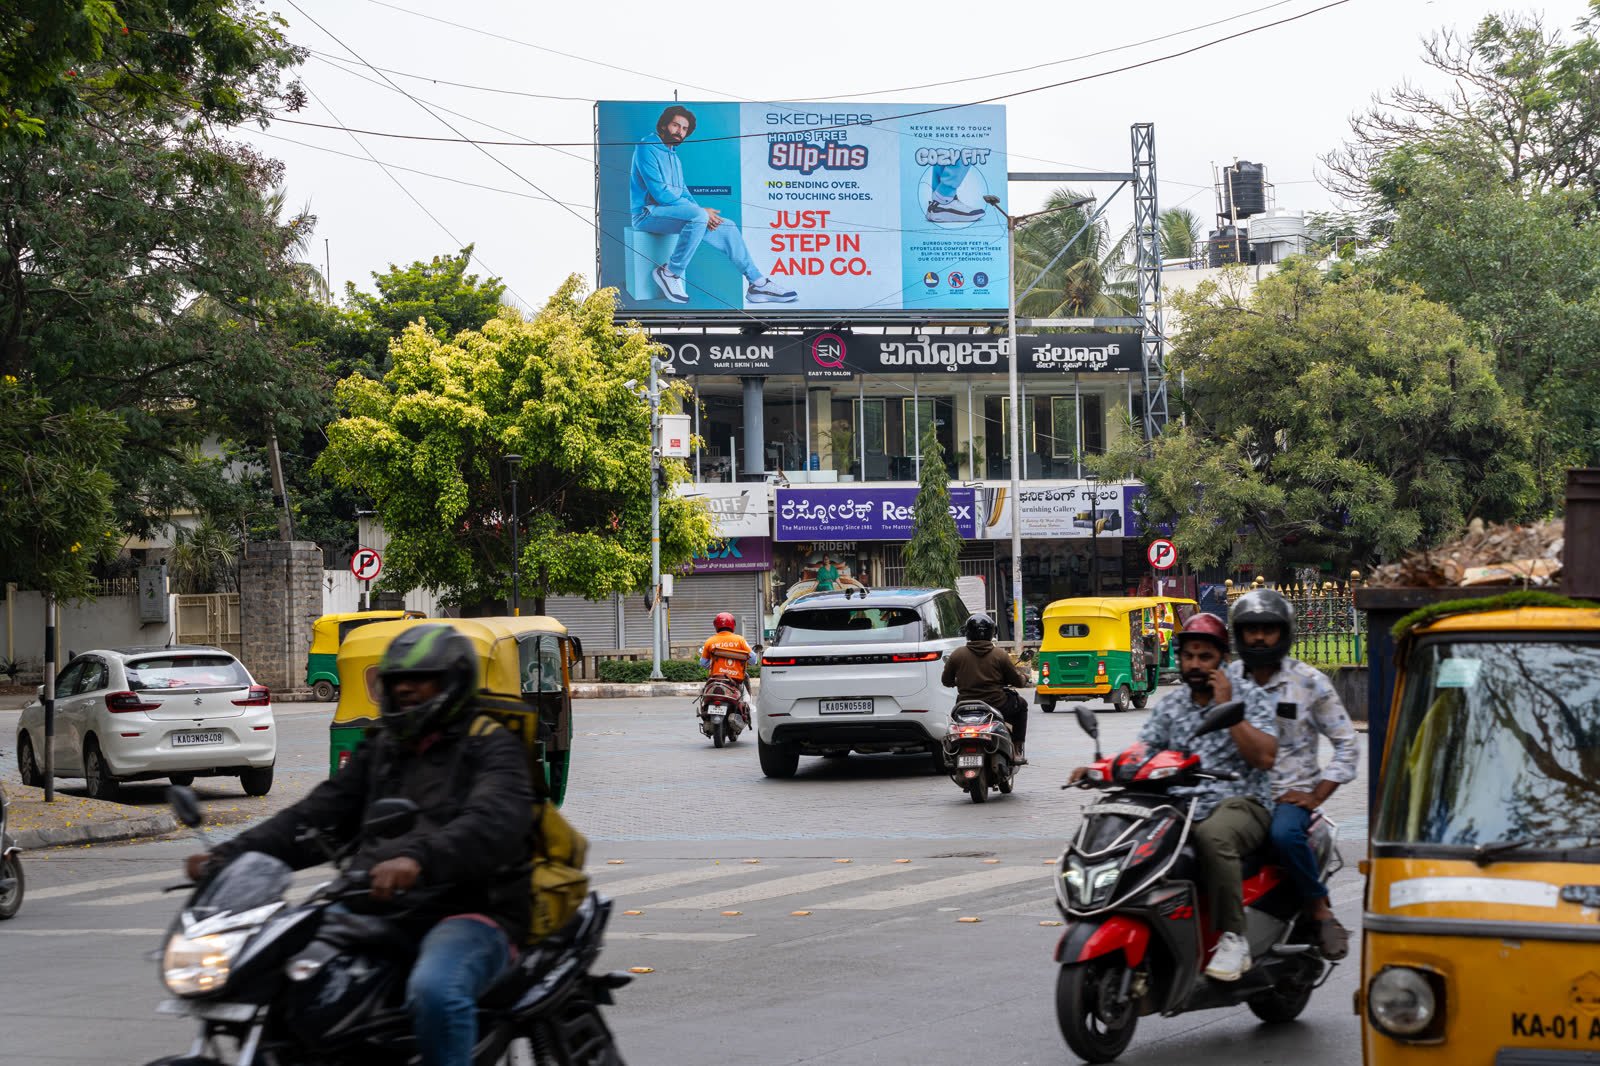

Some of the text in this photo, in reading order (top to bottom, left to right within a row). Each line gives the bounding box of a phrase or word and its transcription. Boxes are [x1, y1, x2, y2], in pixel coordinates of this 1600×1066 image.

[766, 113, 873, 125] SKECHERS
[768, 130, 847, 143] HANDS FREE
[769, 141, 868, 174] Slip-ins
[915, 147, 991, 166] COZY FIT
[768, 181, 860, 189] NO BENDING OVER.
[768, 192, 873, 201] NO TOUCHING SHOES.
[769, 210, 831, 229] JUST
[770, 234, 860, 252] STEP IN
[770, 257, 872, 276] AND GO.
[709, 345, 774, 360] SALON
[1032, 343, 1120, 362] ಸಲೂನ್
[781, 499, 875, 524] ರೆಸ್ಟೋಲೆಕ್ಸ್
[1019, 505, 1076, 513] urnishing Gallery
[812, 541, 857, 551] TRIDENT
[719, 667, 739, 676] Swiggy
[1511, 1011, 1579, 1040] KA-01
